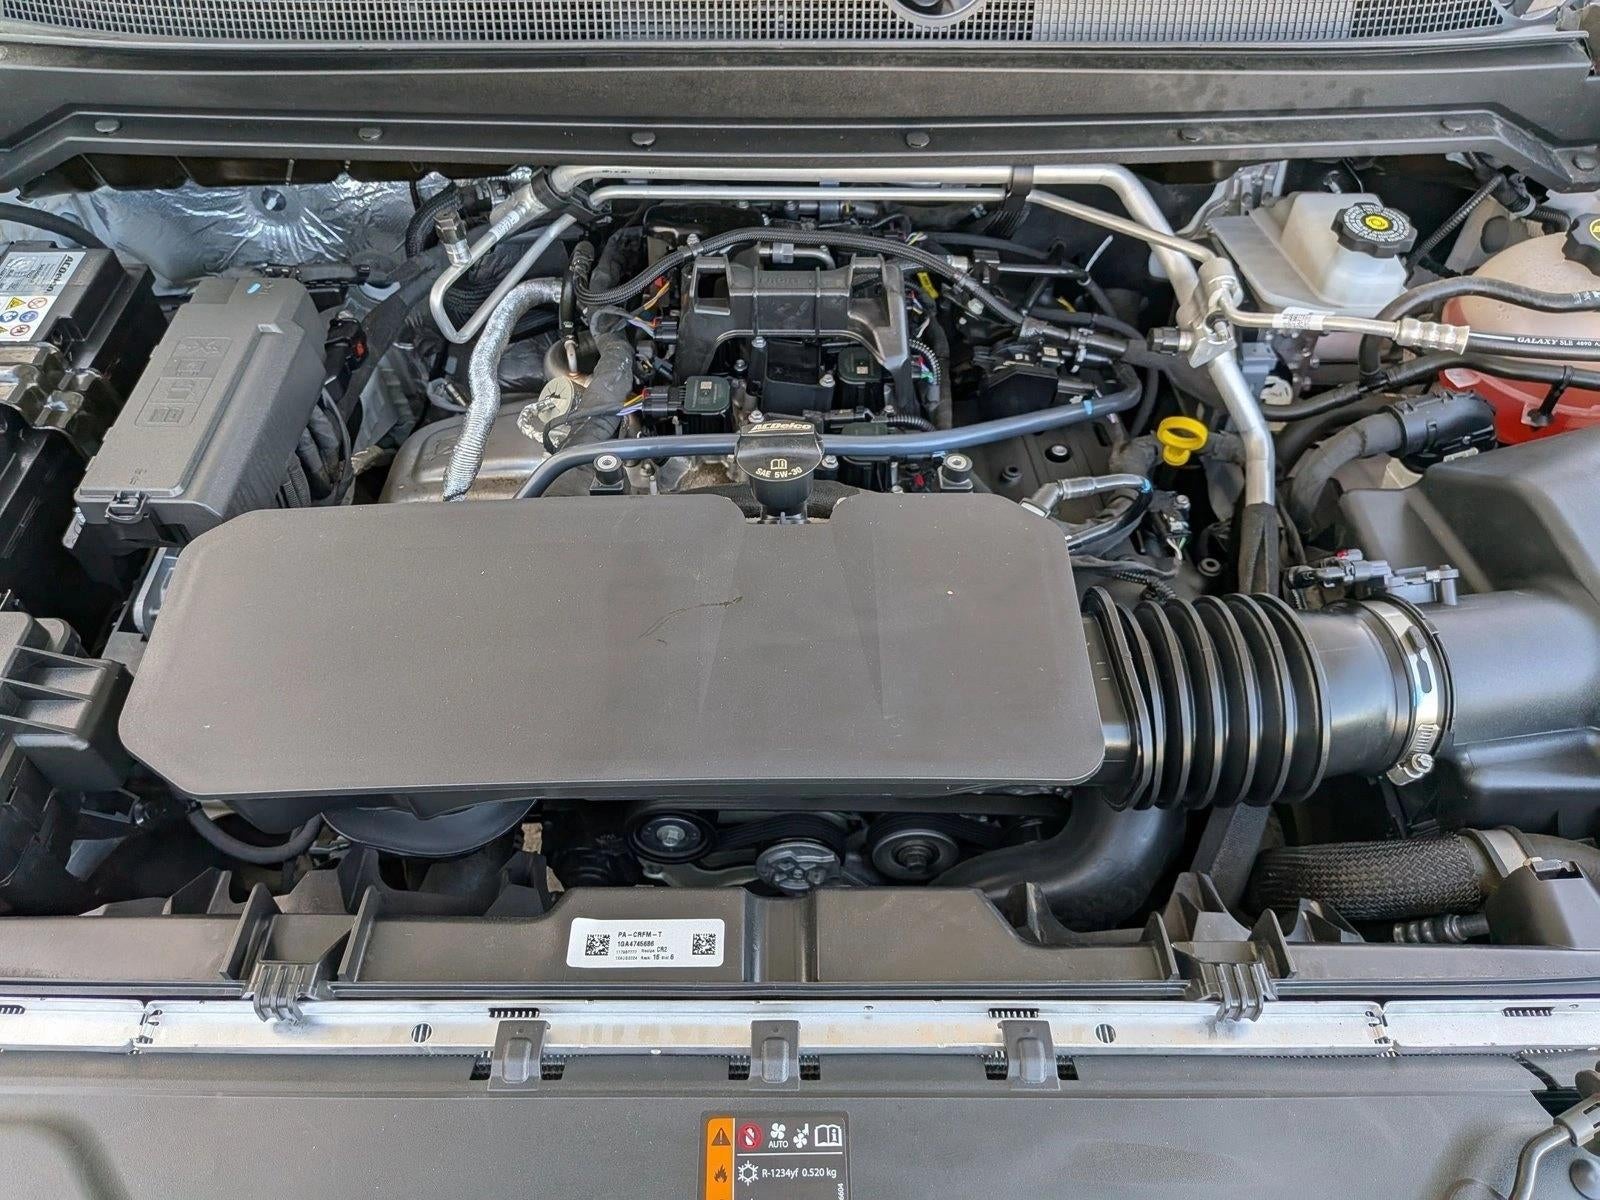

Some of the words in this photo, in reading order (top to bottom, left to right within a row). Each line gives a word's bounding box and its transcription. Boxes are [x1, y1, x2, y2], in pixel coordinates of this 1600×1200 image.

[1517, 336, 1559, 346] GALAXY
[749, 422, 812, 432] ACDelco
[755, 467, 772, 478] SAE
[774, 466, 803, 478] 5W-30
[768, 1140, 789, 1149] AUTO
[762, 1167, 799, 1180] R-1234yf
[801, 1167, 825, 1178] 0.520
[826, 1167, 837, 1179] kg
